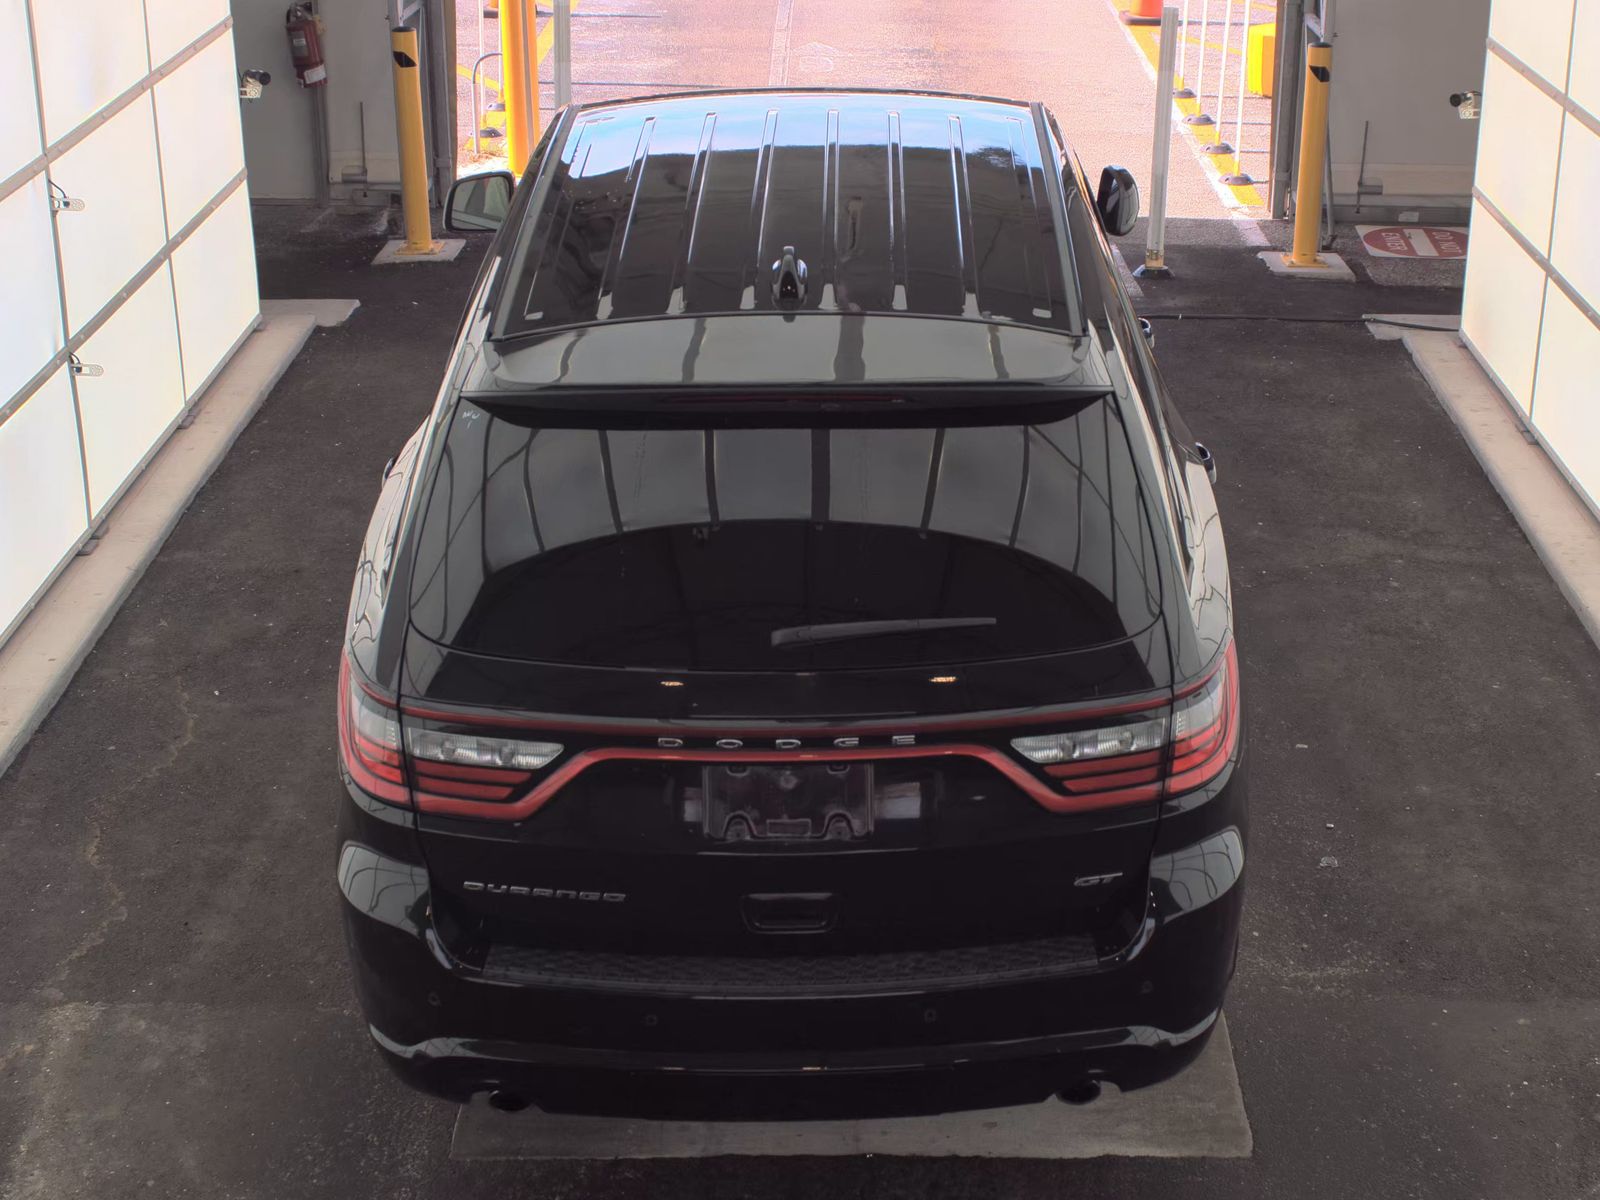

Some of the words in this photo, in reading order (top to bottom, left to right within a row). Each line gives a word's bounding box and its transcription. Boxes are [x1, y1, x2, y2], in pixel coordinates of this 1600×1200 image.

[1381, 232, 1409, 251] ENTER
[1431, 231, 1454, 240] DO
[1439, 241, 1463, 254] NOT
[658, 735, 916, 748] DODGE
[1073, 872, 1123, 887] GT
[463, 881, 627, 901] DURANGO
